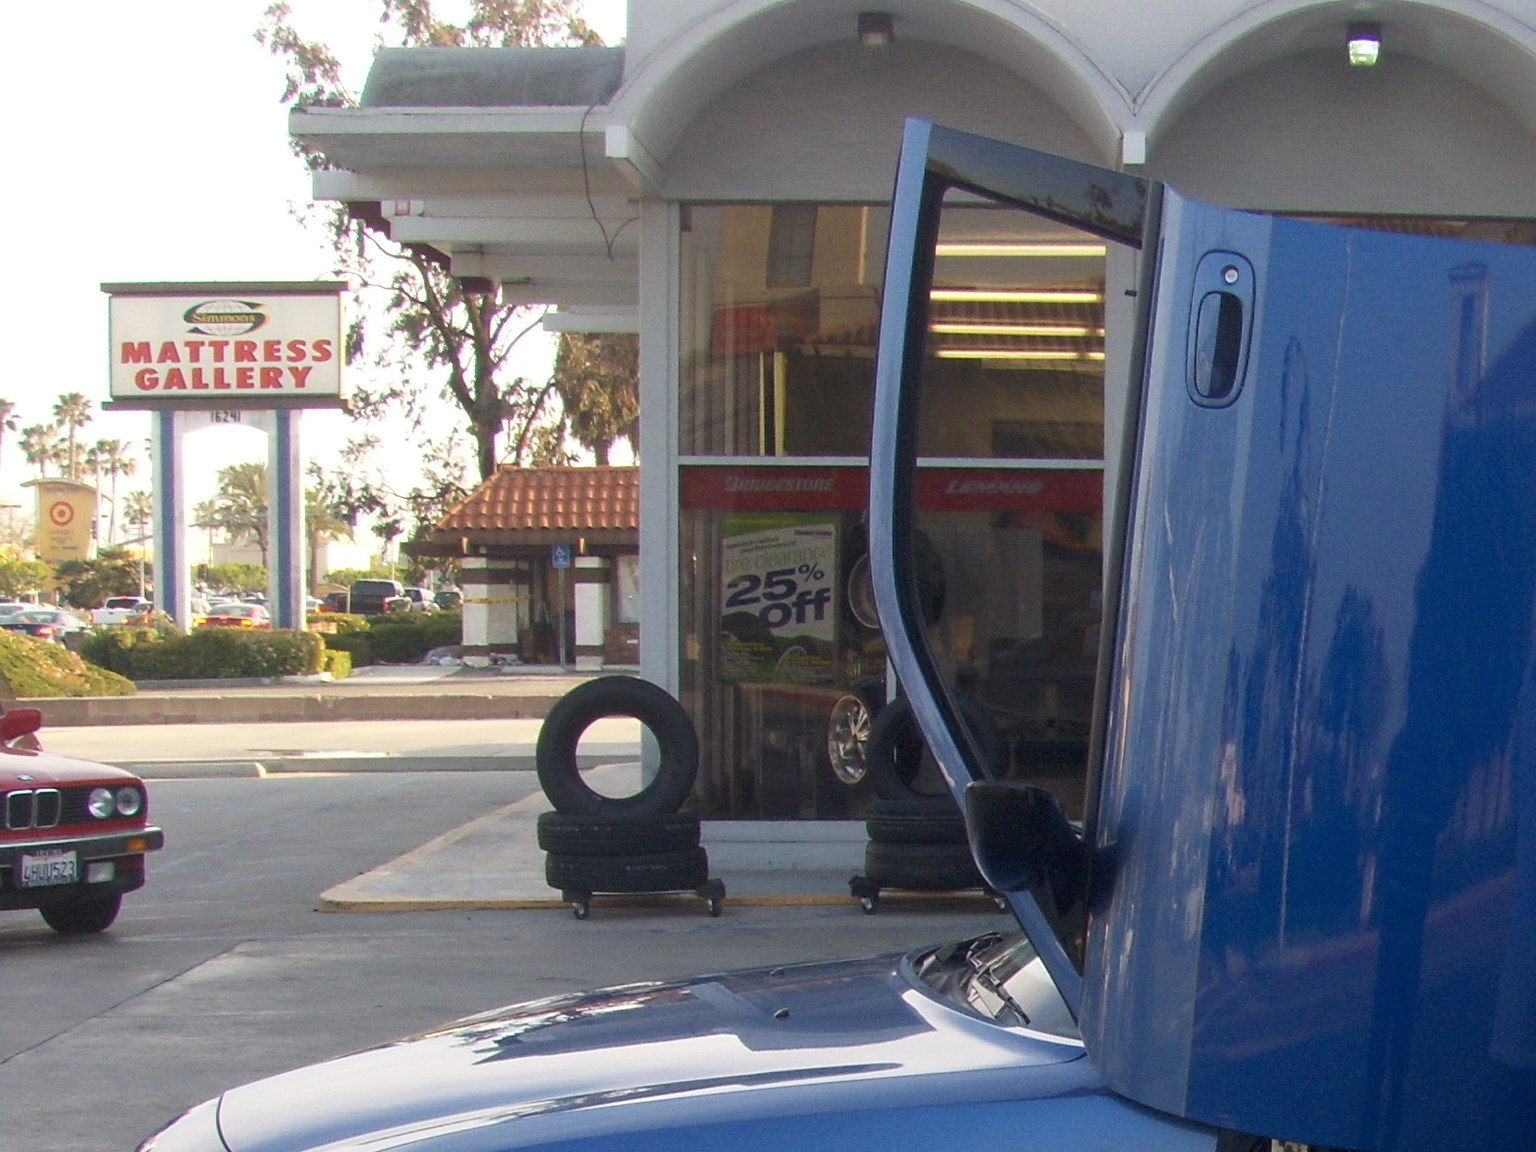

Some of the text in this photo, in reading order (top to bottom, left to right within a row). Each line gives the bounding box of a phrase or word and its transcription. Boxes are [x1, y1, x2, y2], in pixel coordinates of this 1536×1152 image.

[193, 312, 256, 323] Simmons
[121, 339, 332, 364] MATTRESS
[134, 366, 312, 391] GALLERY
[211, 411, 241, 423] 16241
[725, 475, 834, 492] BRIDGESTONE
[725, 562, 824, 607] 25%
[758, 587, 830, 629] off
